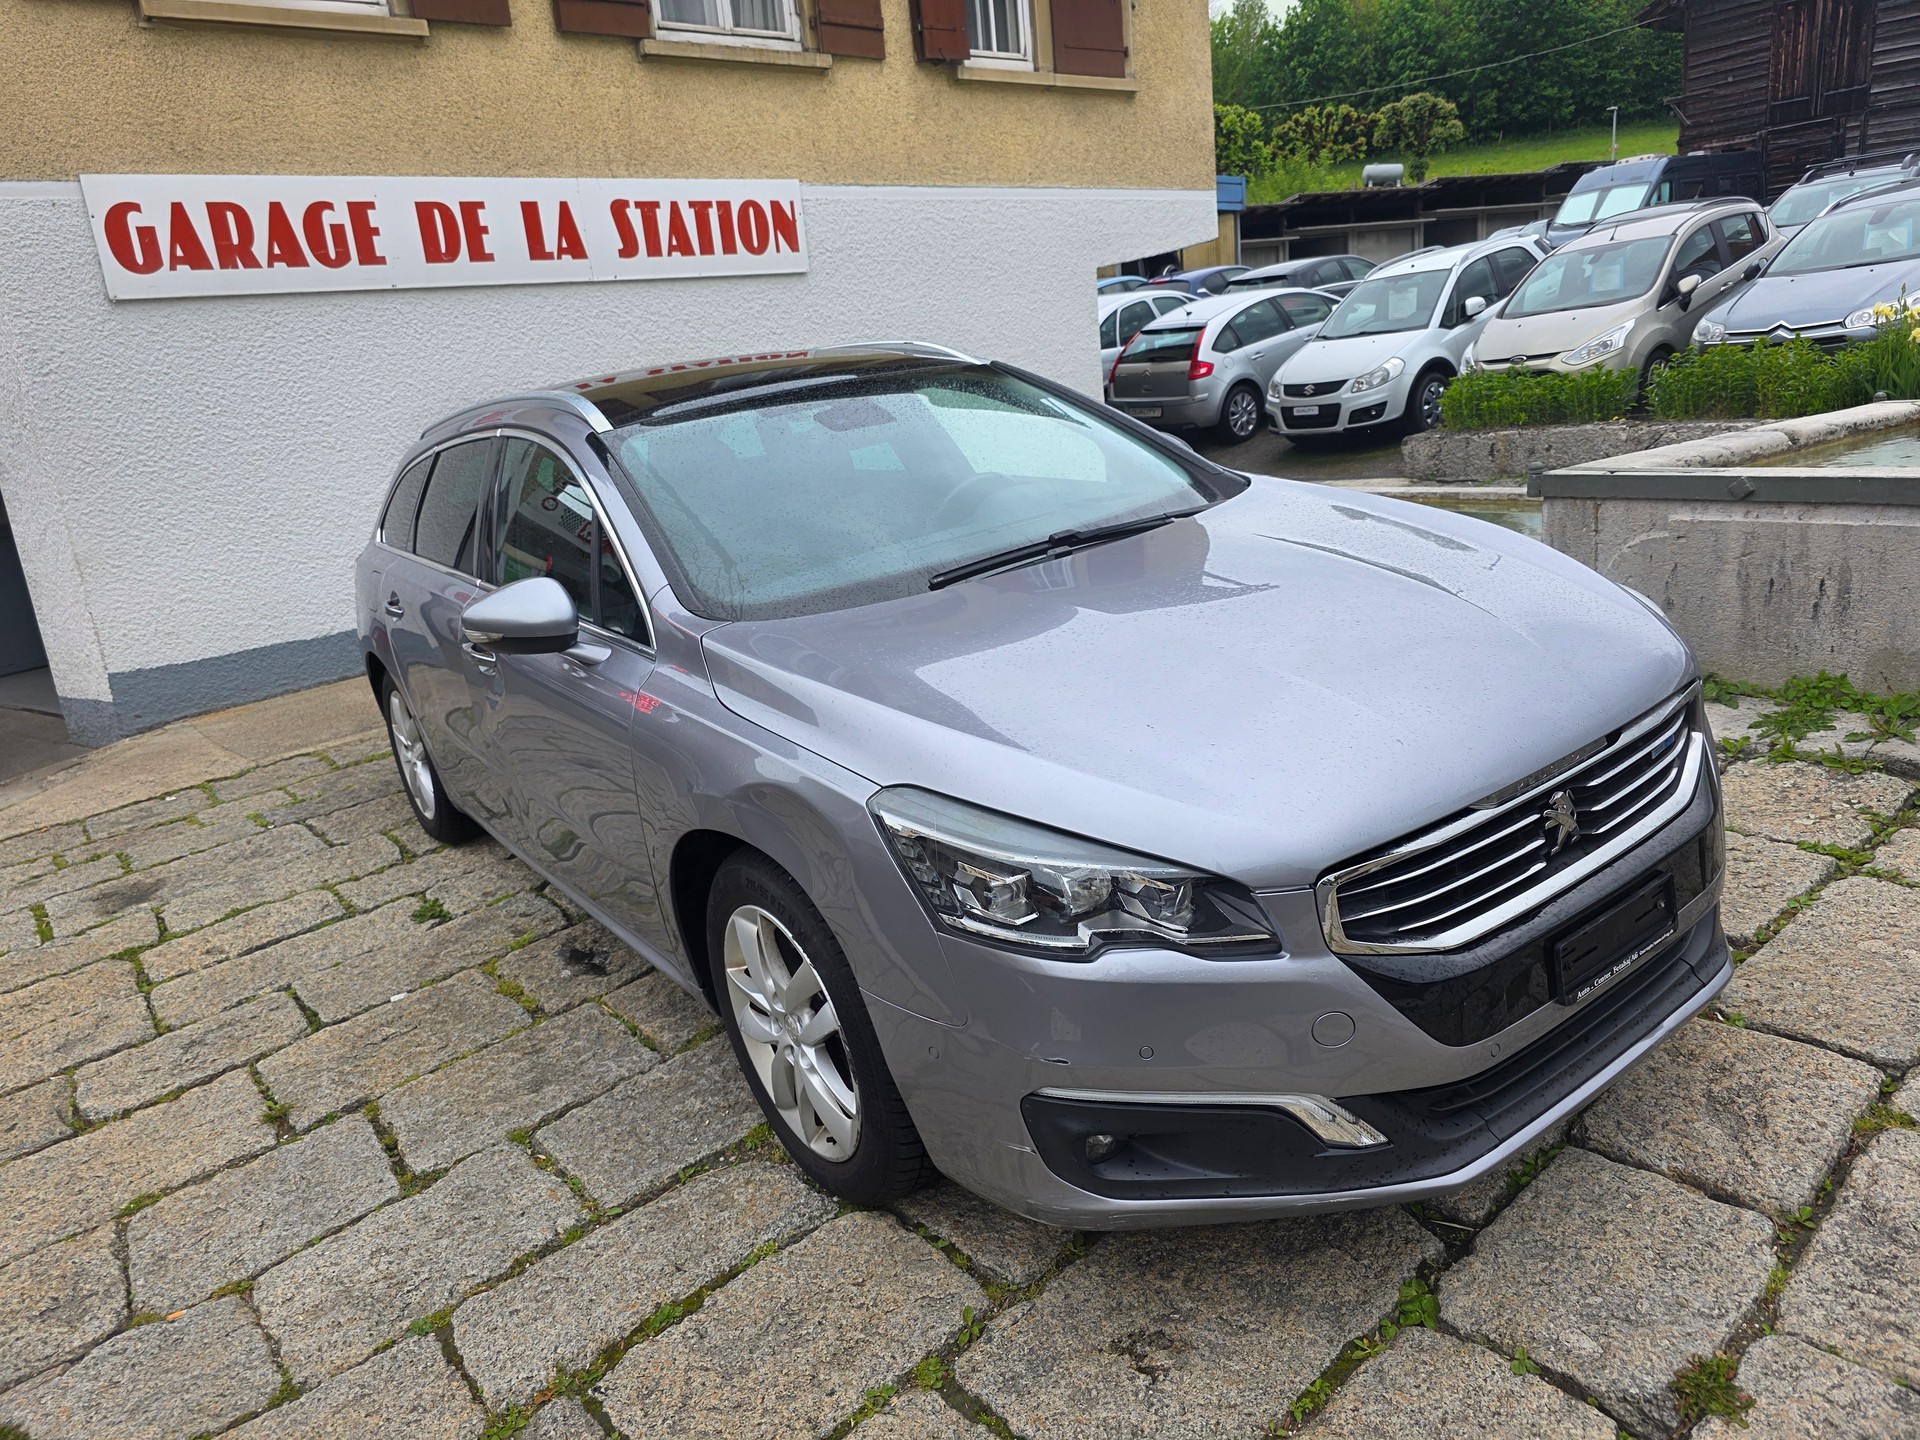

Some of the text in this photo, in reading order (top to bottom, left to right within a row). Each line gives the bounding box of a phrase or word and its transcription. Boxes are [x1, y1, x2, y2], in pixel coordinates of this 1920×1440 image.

[104, 199, 798, 274] GARAGE DE LA STATION
[1577, 986, 1590, 999] Auto
[1594, 971, 1612, 986] Center
